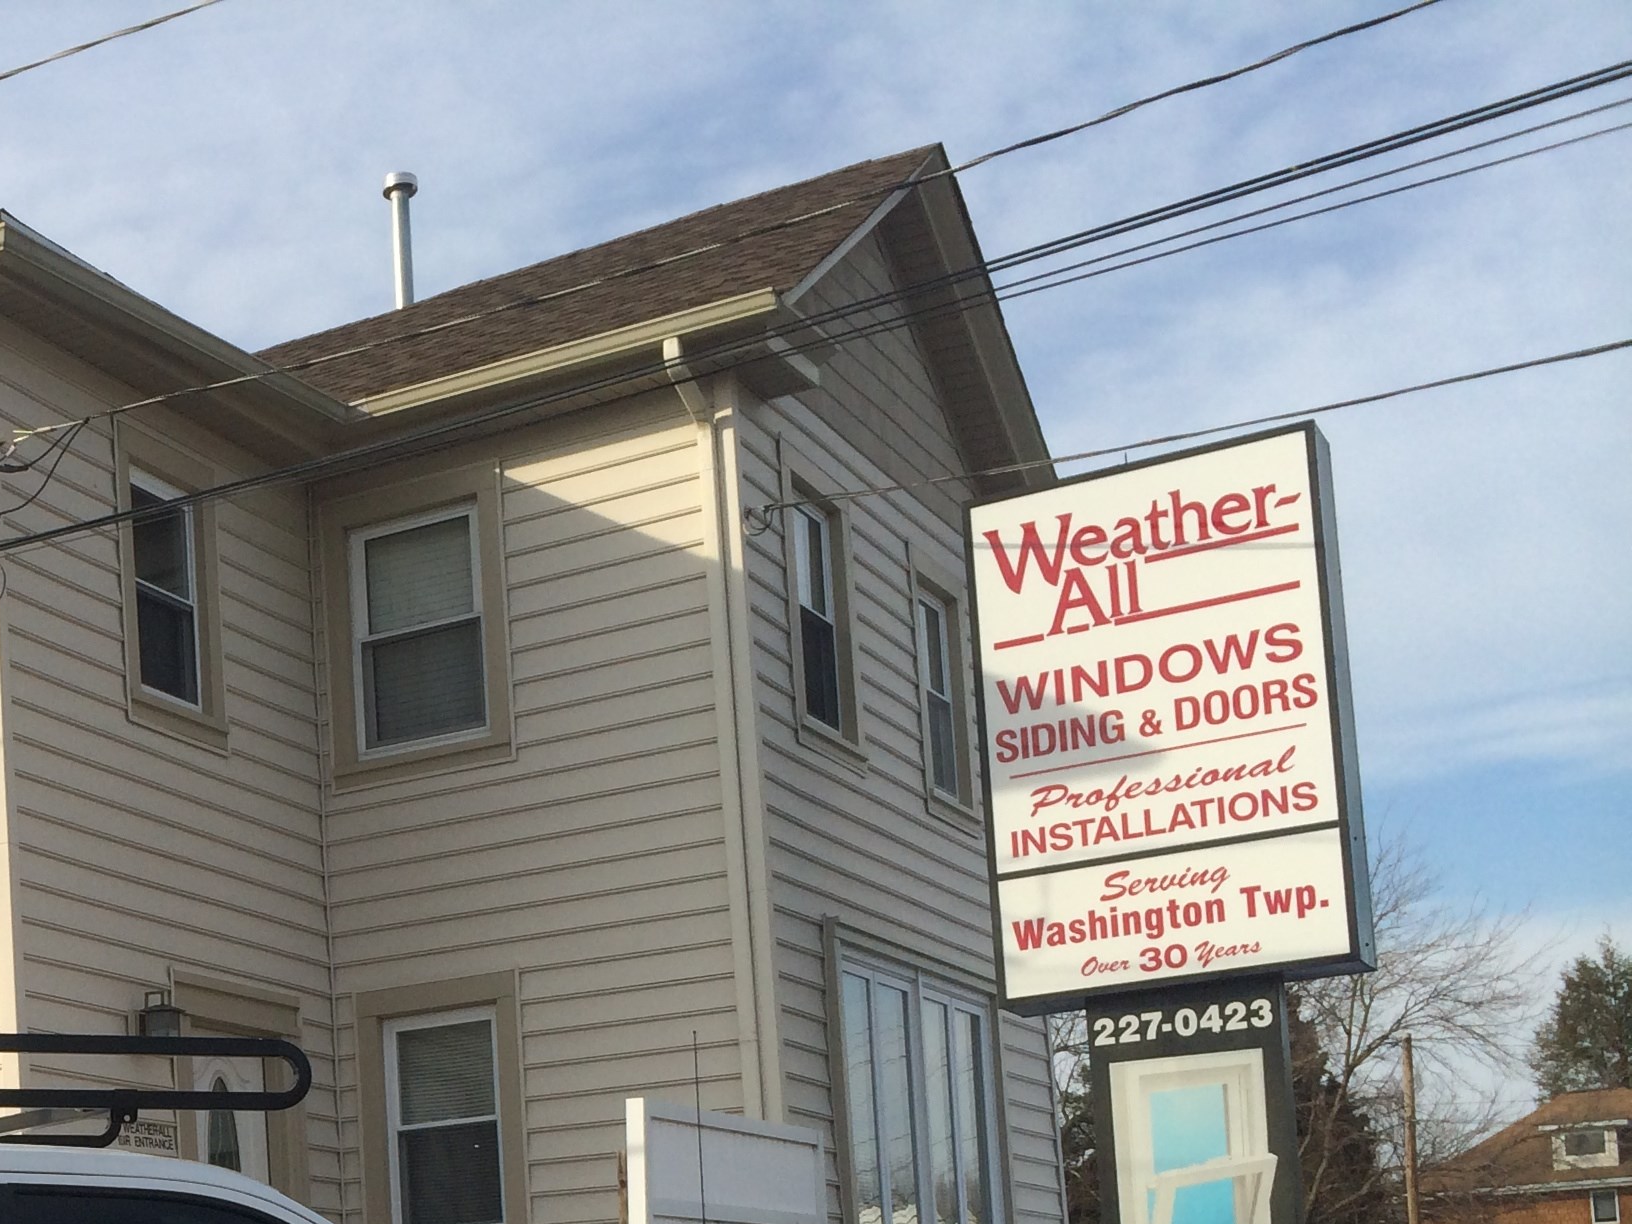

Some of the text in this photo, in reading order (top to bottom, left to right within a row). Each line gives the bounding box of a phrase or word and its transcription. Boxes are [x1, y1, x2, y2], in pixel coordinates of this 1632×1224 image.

[982, 483, 1301, 594] Weather-
[1046, 560, 1142, 637] All
[995, 622, 1304, 715] WINDOWS
[995, 673, 1318, 763] SIDING & DOORS
[1030, 745, 1297, 817] Professional
[1010, 781, 1319, 858] INSTALLATIONS
[1012, 884, 1329, 951] Washington Twp.
[1099, 865, 1230, 902] Serving
[1080, 939, 1263, 977] Over 30 Years
[1093, 998, 1273, 1046] 227-0423
[134, 1135, 174, 1151] ENTRANCE
